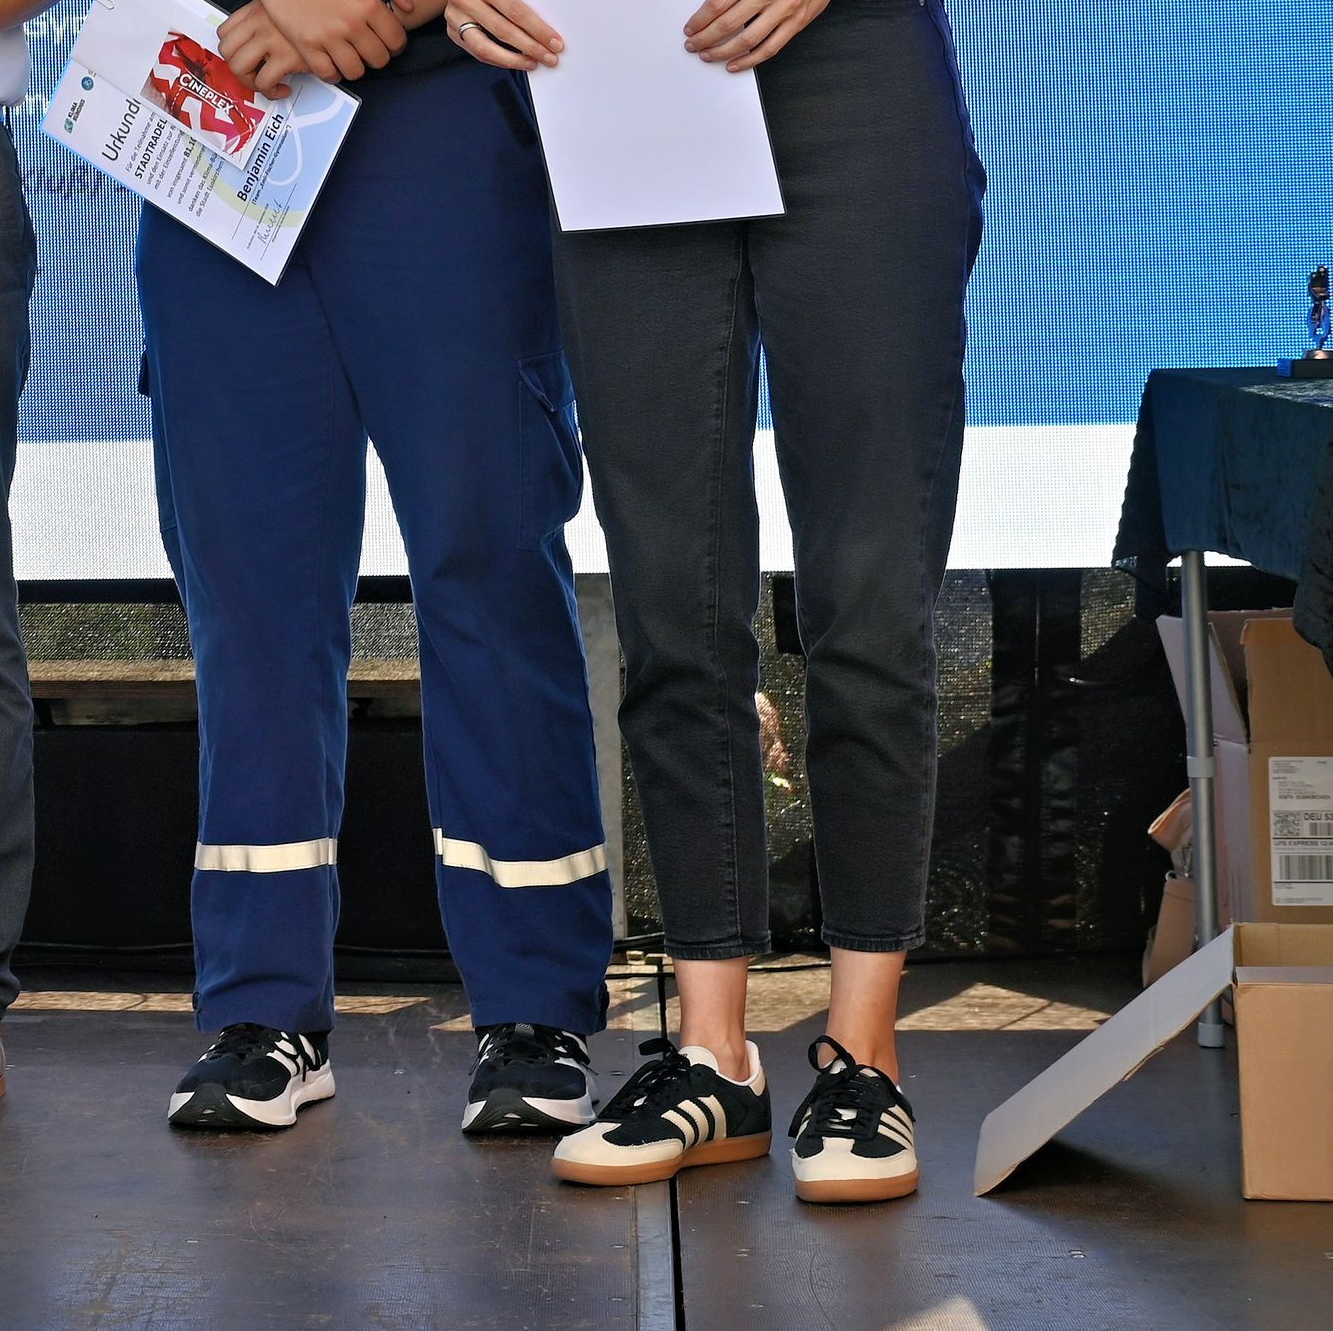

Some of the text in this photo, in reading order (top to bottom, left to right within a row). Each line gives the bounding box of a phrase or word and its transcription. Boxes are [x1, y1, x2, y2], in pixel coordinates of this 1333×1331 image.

[179, 74, 233, 114] CINEPLEX
[237, 143, 270, 201] Benjamin
[265, 114, 284, 141] Eich
